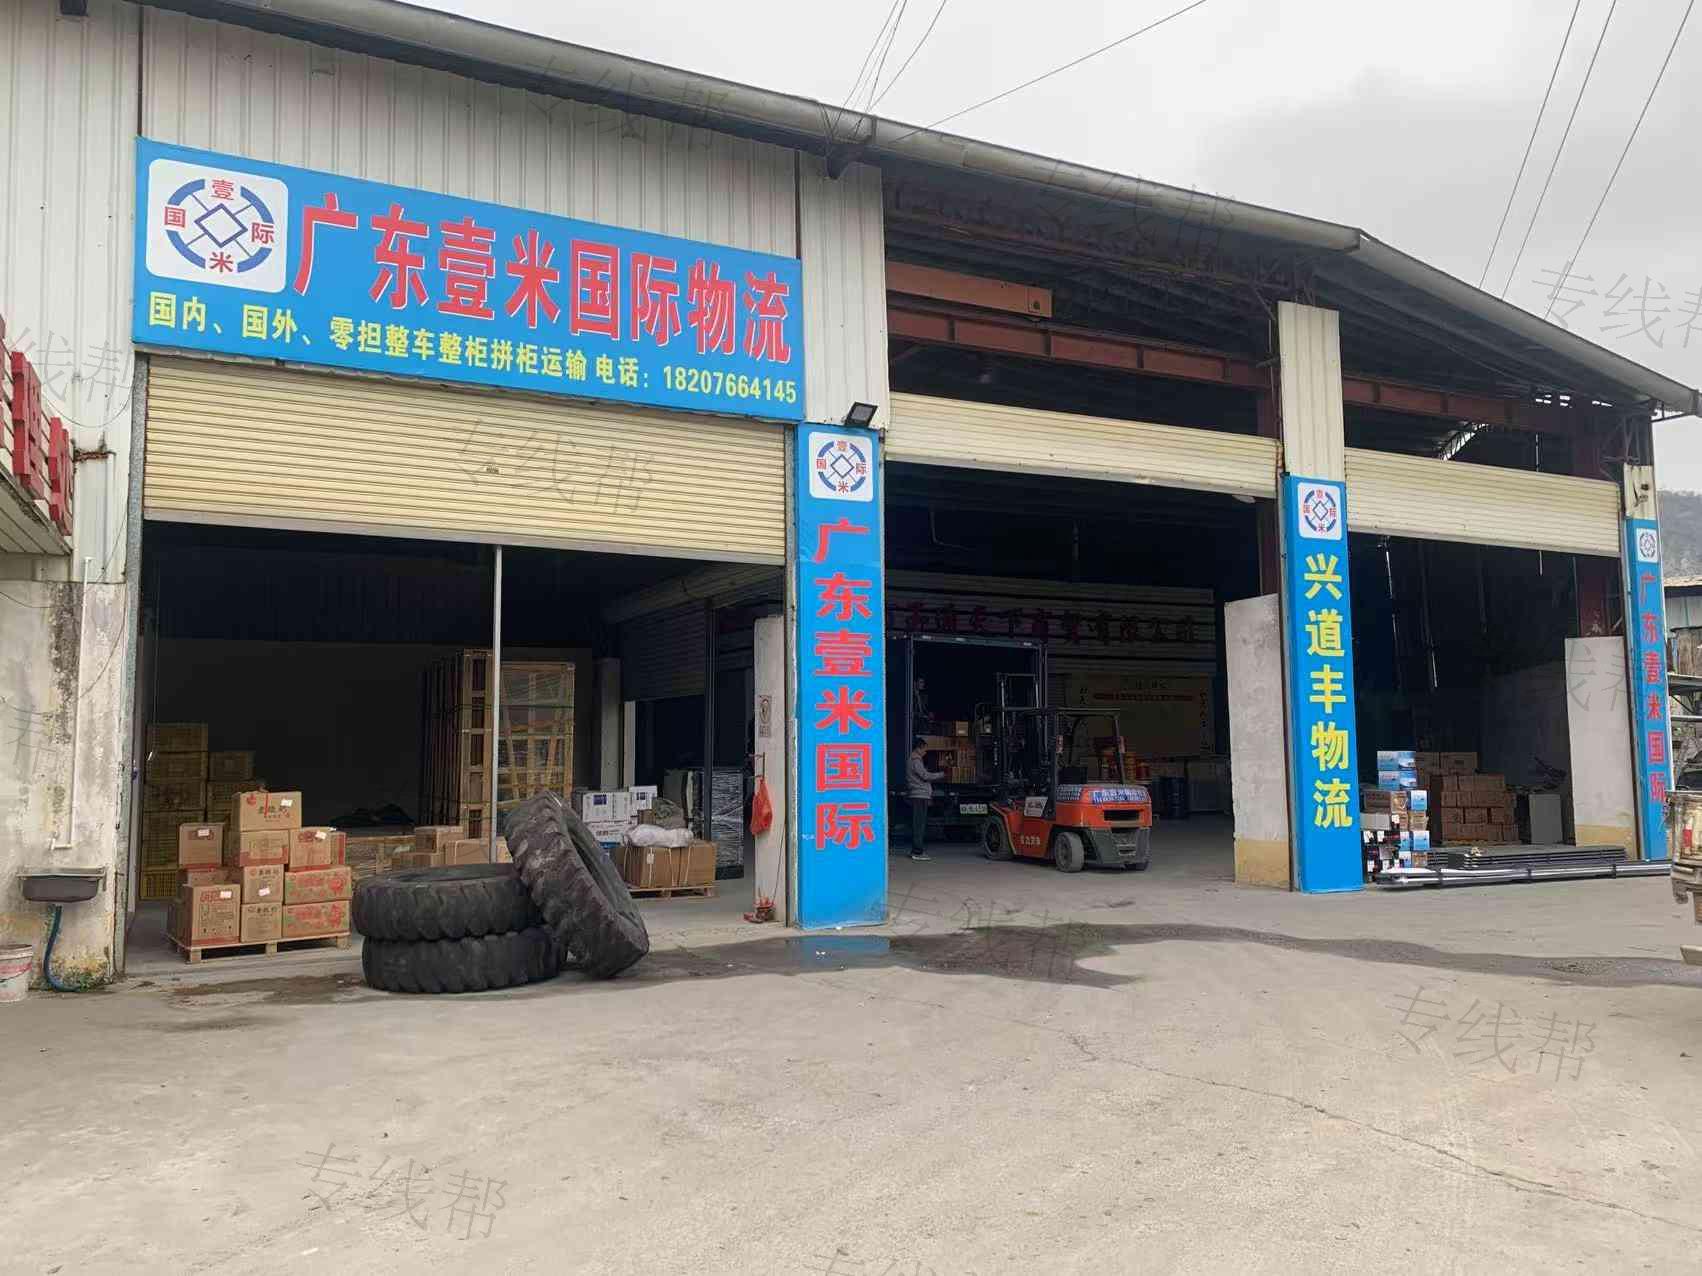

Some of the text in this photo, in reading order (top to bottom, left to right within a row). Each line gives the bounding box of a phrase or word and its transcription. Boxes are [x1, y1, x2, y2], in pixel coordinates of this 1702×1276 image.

[164, 206, 186, 228] 国
[251, 222, 274, 245] 际
[209, 251, 234, 273] 米
[294, 191, 792, 365] 广东壹米国际物流
[662, 365, 798, 404] 18207664145
[813, 517, 875, 850] 广东壹米国际
[1303, 552, 1353, 829] 兴道丰物流
